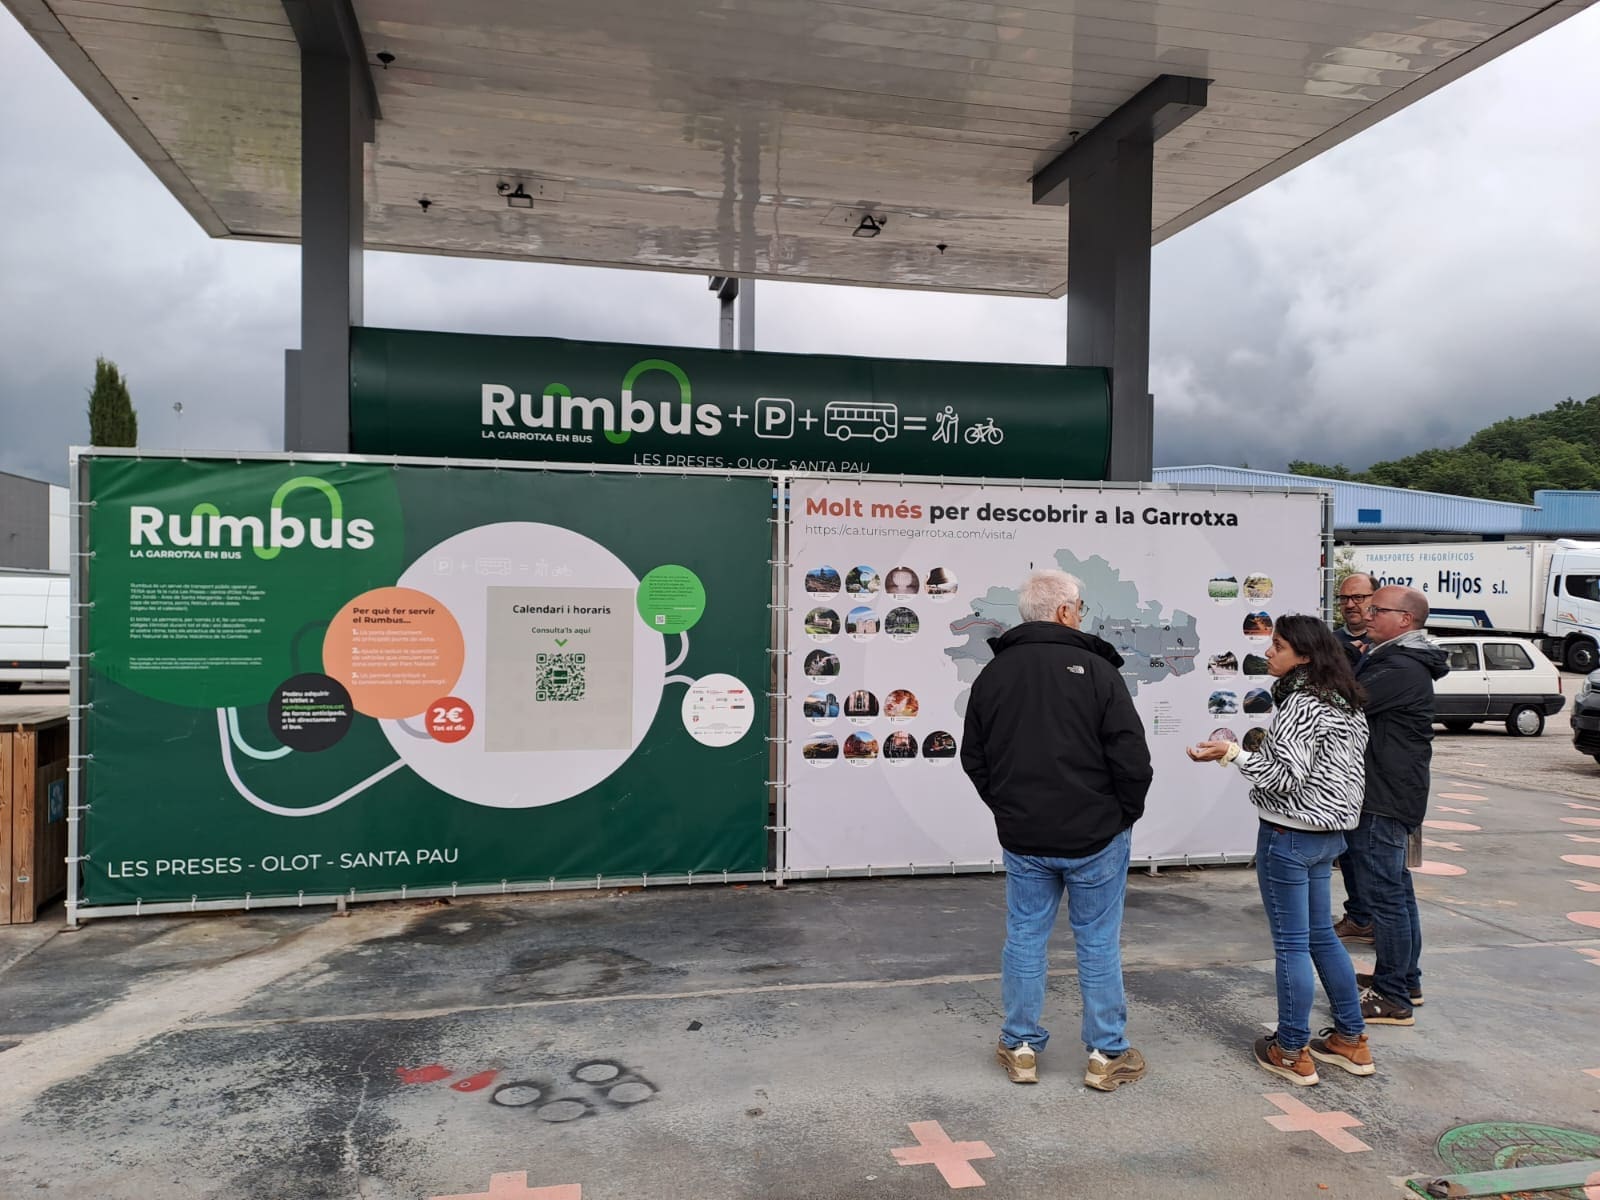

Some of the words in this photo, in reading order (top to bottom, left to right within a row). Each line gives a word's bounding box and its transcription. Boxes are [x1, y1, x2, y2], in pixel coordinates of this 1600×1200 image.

[481, 382, 722, 442] Rumbus
[765, 406, 786, 431] P
[482, 430, 495, 439] LA
[497, 431, 553, 442] GARROTXA
[555, 434, 570, 442] EN
[572, 434, 592, 444] BUS
[633, 453, 661, 466] LES
[666, 455, 724, 468] PRESES
[737, 457, 778, 470] OLOT
[789, 460, 836, 472] SANTA
[840, 461, 870, 474] PAU
[806, 497, 863, 517] Molt
[871, 500, 923, 519] més
[930, 504, 970, 524] per
[976, 502, 1088, 524] descobrir
[1094, 510, 1108, 524] a
[1115, 506, 1135, 525] la
[1142, 507, 1238, 526] Garrotxa
[130, 503, 375, 557] Rumbus
[804, 524, 1017, 540] https://ca.turismegarrotxa.com/visita/
[130, 550, 144, 558] LA
[145, 550, 202, 559] GARROTXA
[204, 551, 219, 560] EN
[220, 552, 242, 560] BUS
[1366, 552, 1415, 562] TRANSPORTES
[1419, 552, 1474, 561] FRIGORÍFICOS
[1422, 582, 1429, 593] e
[1438, 570, 1482, 600] Hijos
[1492, 580, 1508, 594] s.l.
[352, 607, 370, 615] Per
[372, 607, 390, 616] què
[512, 604, 564, 614] Calendari
[567, 605, 570, 614] i
[573, 605, 612, 615] horaris
[352, 616, 362, 624] el
[531, 626, 572, 634] Consulta'ls
[574, 626, 591, 636] aquí
[432, 707, 465, 724] 2€
[107, 860, 149, 878] LES
[156, 857, 242, 876] PRESES
[261, 854, 322, 872] OLOT
[340, 850, 410, 869] SANTA
[416, 848, 458, 865] PAU
